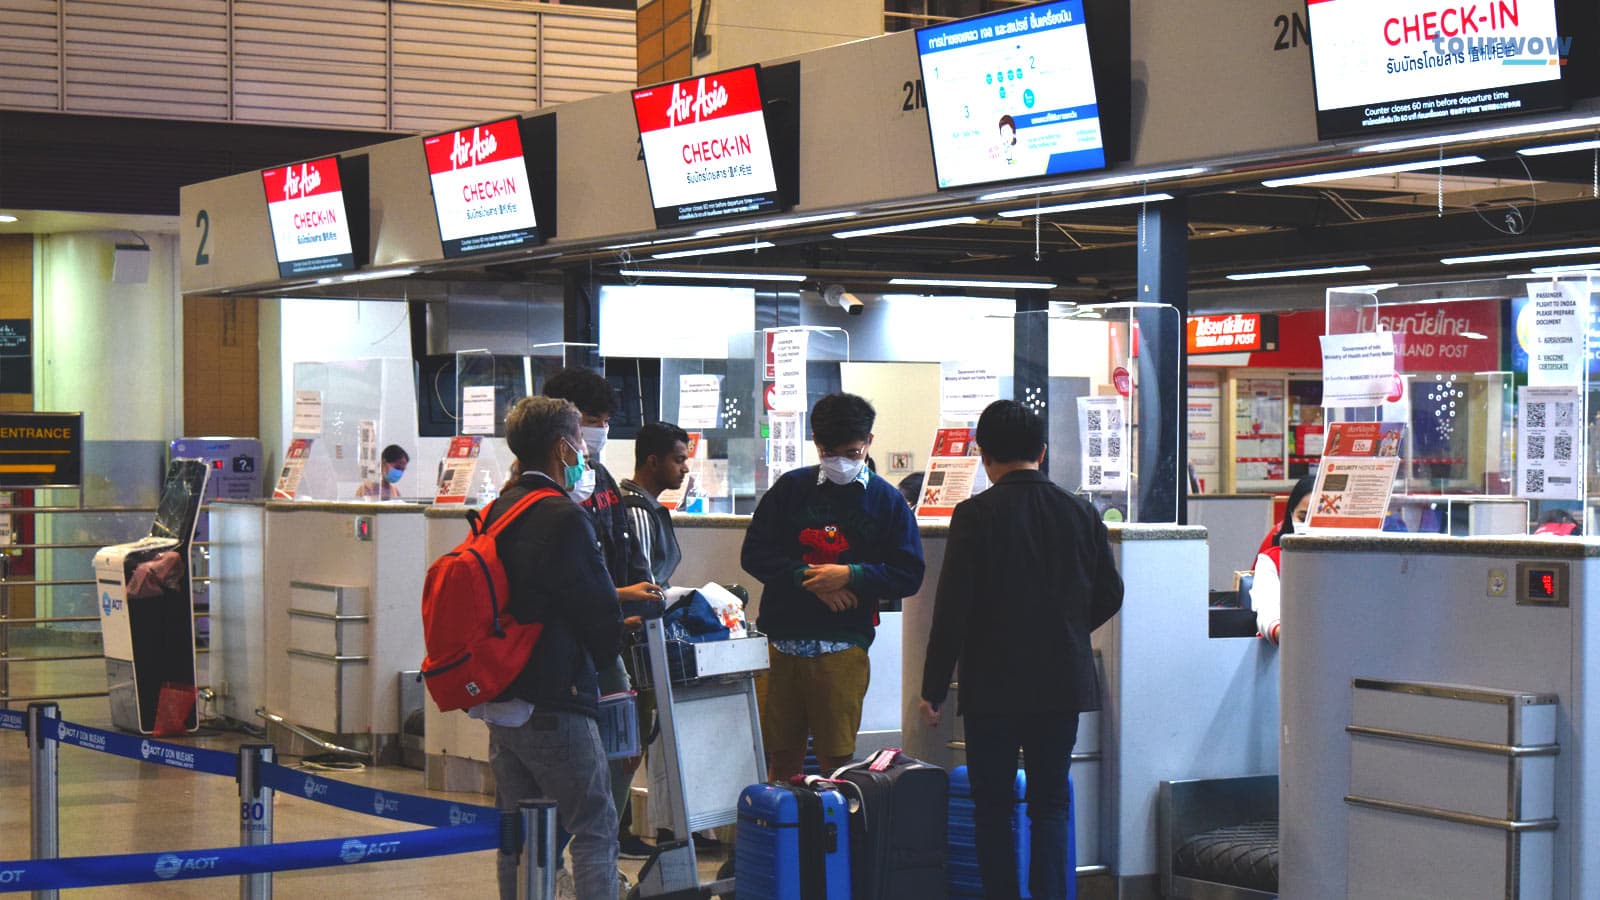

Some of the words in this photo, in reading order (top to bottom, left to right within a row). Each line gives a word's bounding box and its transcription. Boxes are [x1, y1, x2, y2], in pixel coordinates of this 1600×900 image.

[1384, 0, 1518, 46] CHECK-IN
[1365, 105, 1390, 116] Counter
[1391, 104, 1411, 113] closes
[1423, 101, 1435, 109] min
[1436, 97, 1457, 107] before
[1459, 94, 1492, 105] departure
[1493, 91, 1509, 100] time
[682, 133, 752, 165] CHECK-IN
[463, 178, 517, 202] CHECK-IN
[294, 209, 337, 230] CHECK-IN
[196, 210, 210, 265] 2
[1439, 345, 1468, 358] POST
[0, 427, 71, 440] ENTRANCE
[241, 802, 264, 820] 80
[366, 840, 400, 856] AOT
[181, 856, 219, 870] AOT
[0, 869, 25, 883] OT
